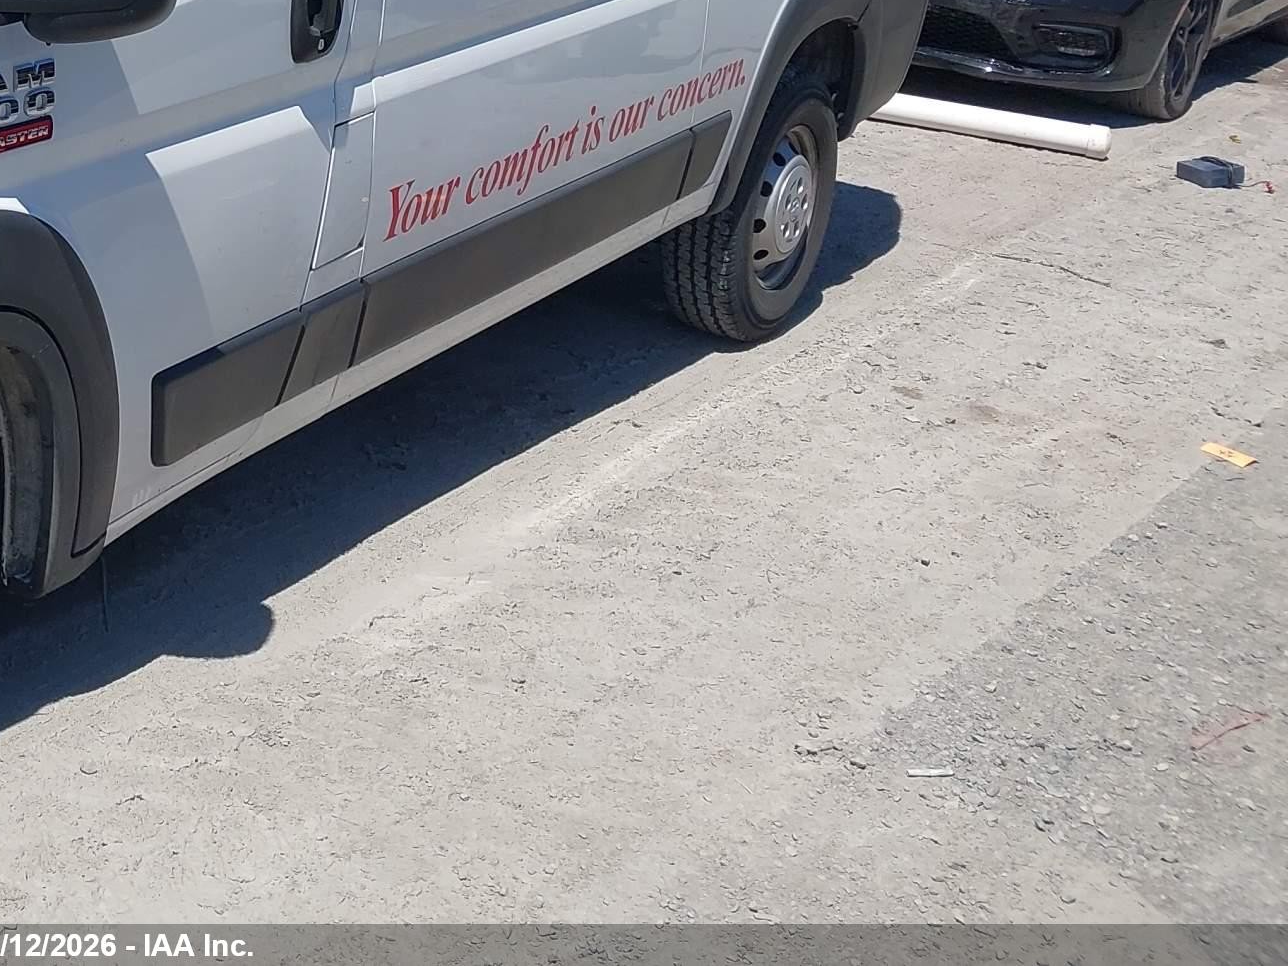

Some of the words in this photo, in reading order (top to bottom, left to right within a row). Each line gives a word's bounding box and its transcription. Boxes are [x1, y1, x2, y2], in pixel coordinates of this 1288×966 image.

[383, 175, 460, 242] Your
[465, 121, 580, 204] comfort
[581, 105, 604, 155] is
[609, 96, 655, 143] our
[657, 58, 746, 122] concern.
